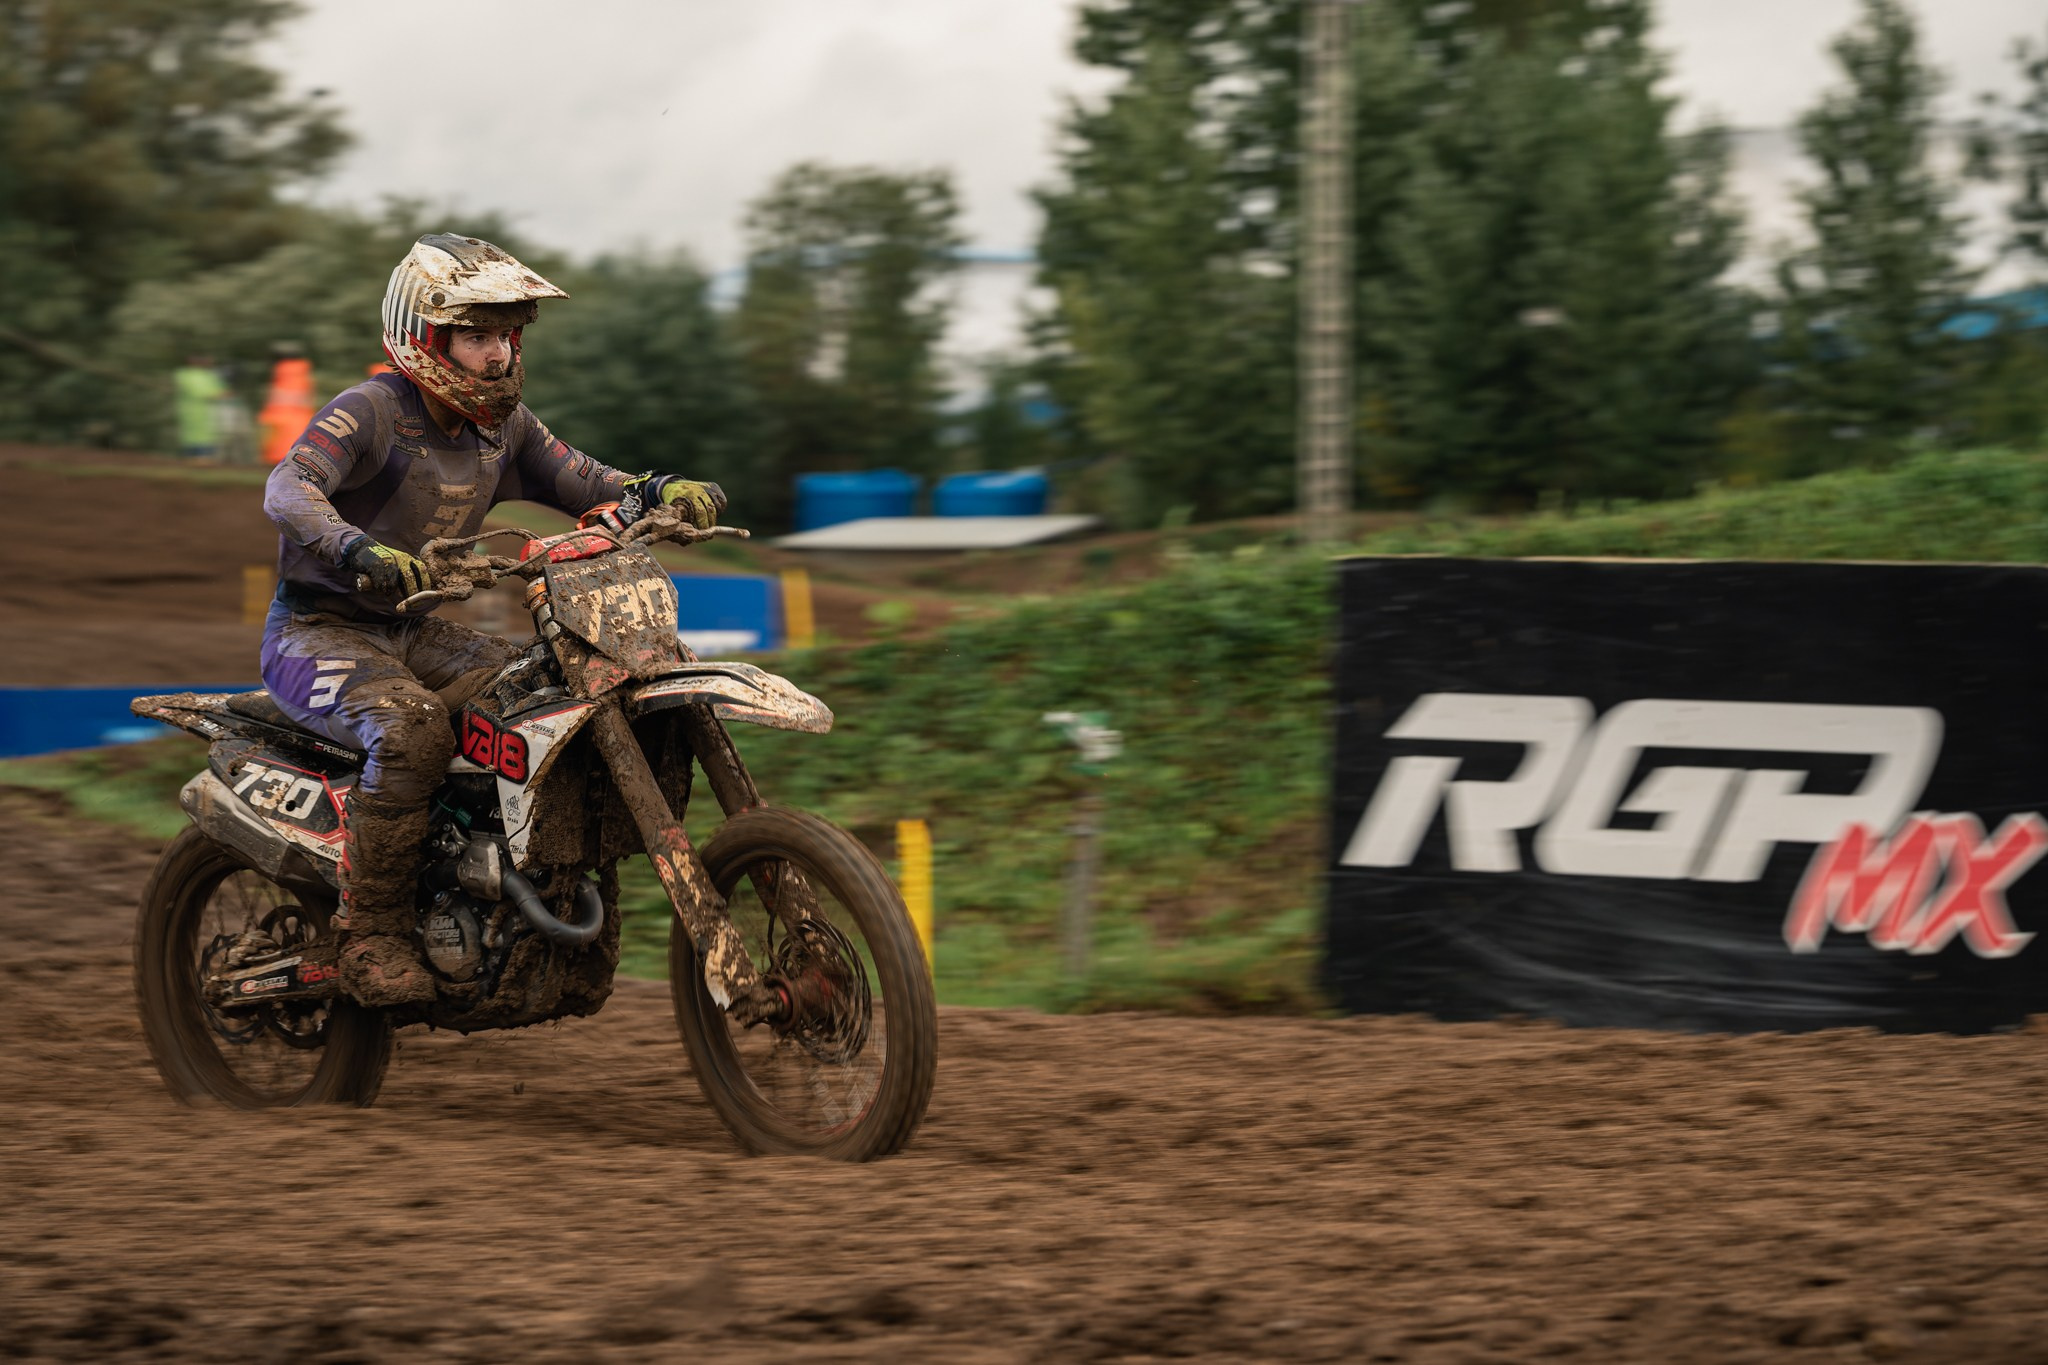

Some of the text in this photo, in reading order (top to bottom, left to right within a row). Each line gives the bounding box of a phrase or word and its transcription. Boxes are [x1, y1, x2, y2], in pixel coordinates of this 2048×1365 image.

[571, 577, 676, 643] 730
[232, 761, 324, 820] 730
[1340, 693, 1945, 882] RGP
[1783, 811, 2048, 958] MX
